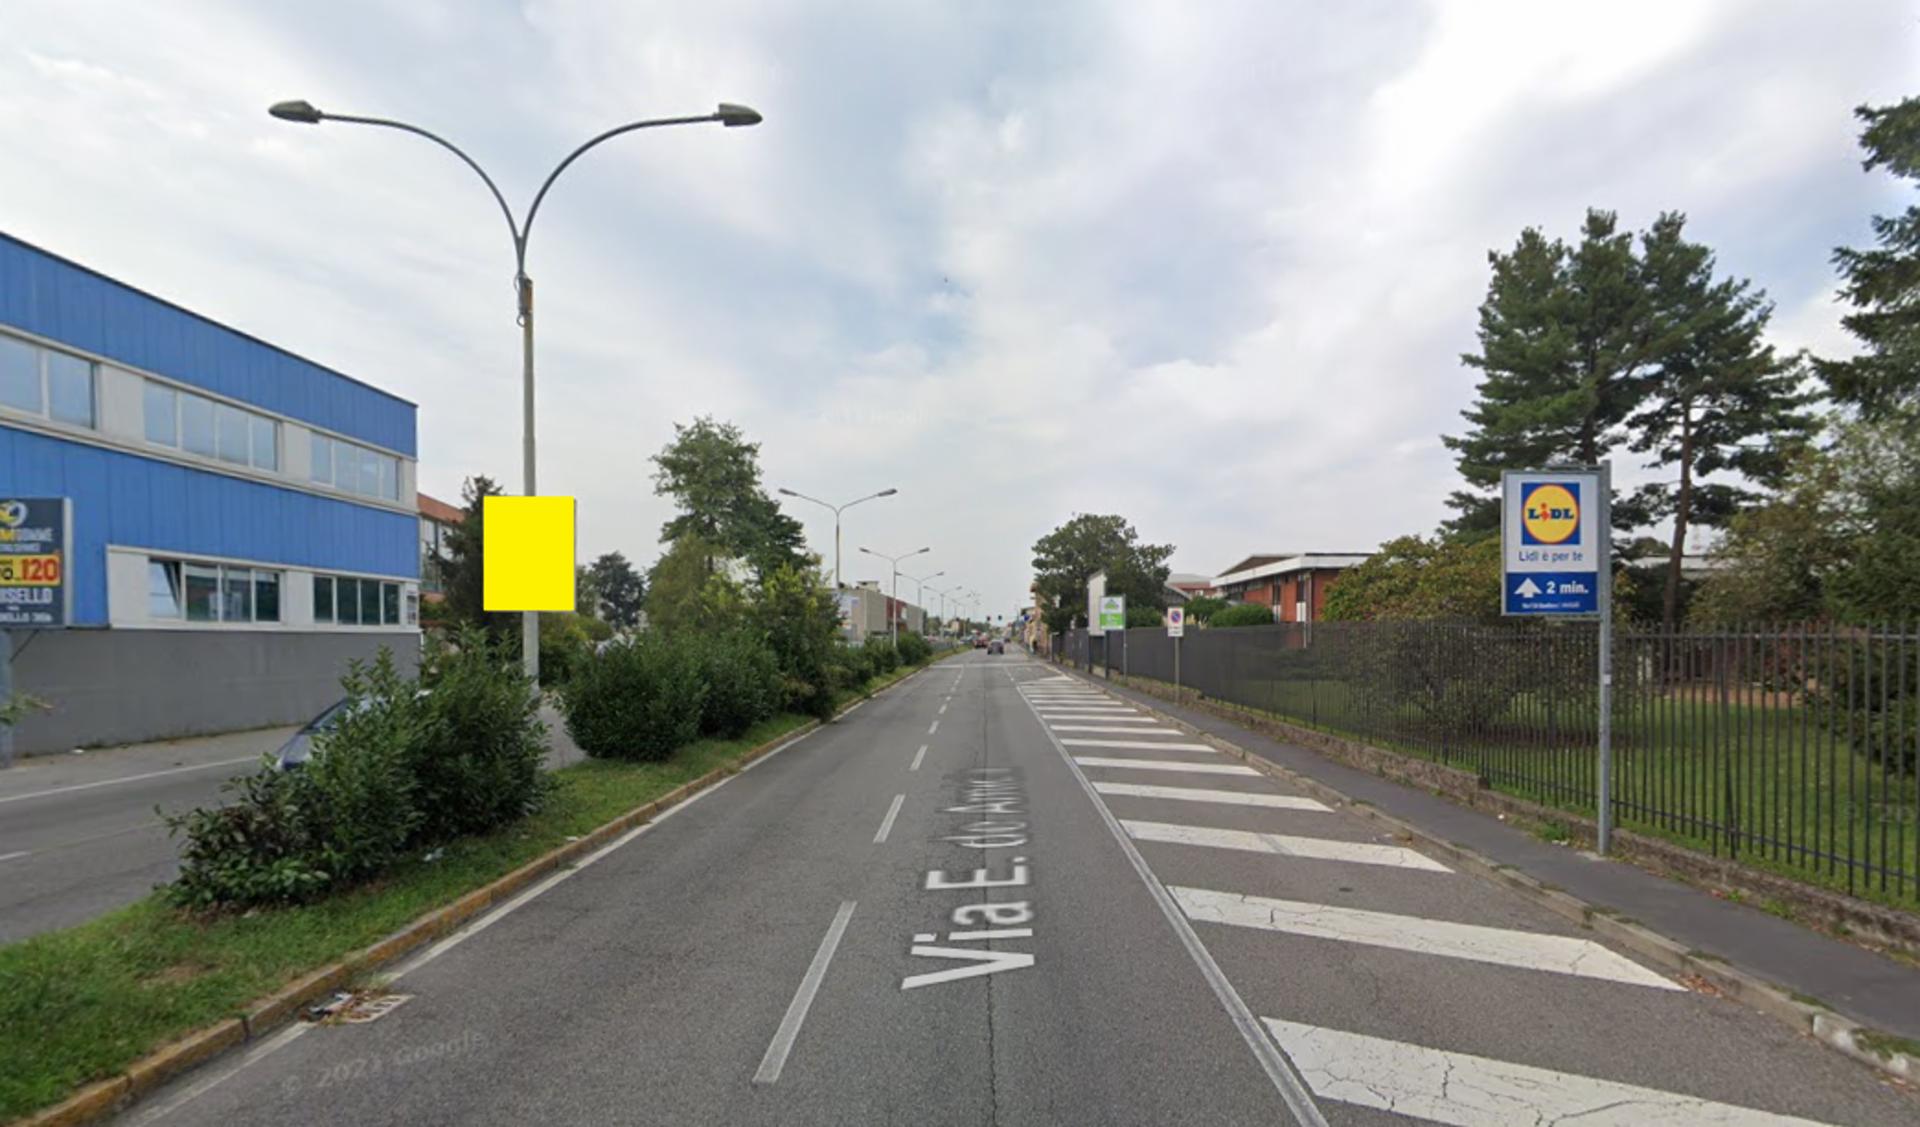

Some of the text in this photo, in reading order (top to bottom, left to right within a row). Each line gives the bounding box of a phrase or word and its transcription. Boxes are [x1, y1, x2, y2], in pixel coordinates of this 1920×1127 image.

[1518, 551, 1539, 562] Lidl
[1552, 552, 1570, 564] per
[1572, 551, 1584, 562] te
[20, 559, 57, 581] 120
[1546, 580, 1589, 594] 2 min.
